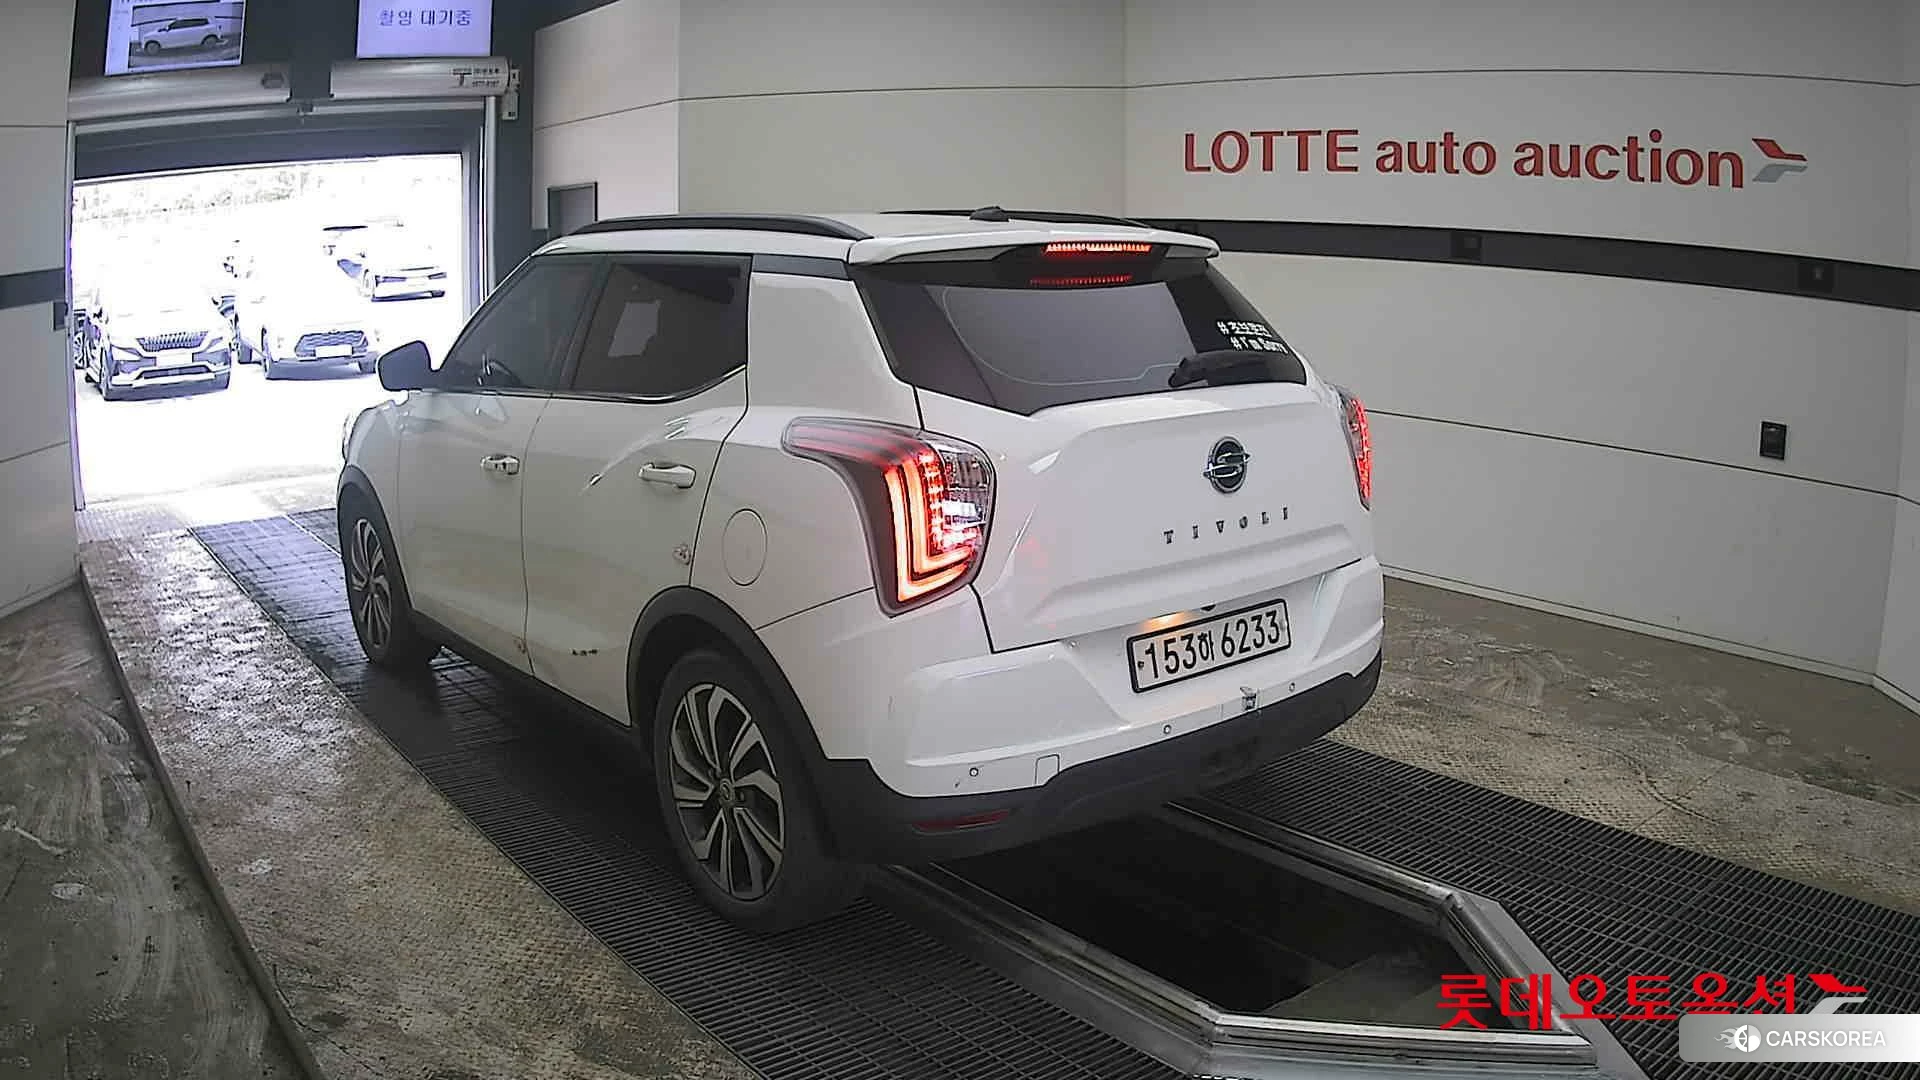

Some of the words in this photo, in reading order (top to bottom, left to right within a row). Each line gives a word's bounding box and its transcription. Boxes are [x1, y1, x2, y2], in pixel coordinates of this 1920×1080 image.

[421, 9, 472, 26] 대기중
[1184, 129, 1359, 173] LOTTE
[1375, 131, 1497, 176] auto
[1513, 128, 1744, 189] auction
[1163, 506, 1289, 545] TIVOLI
[1144, 629, 1215, 679] 153하
[1221, 609, 1281, 658] 6233
